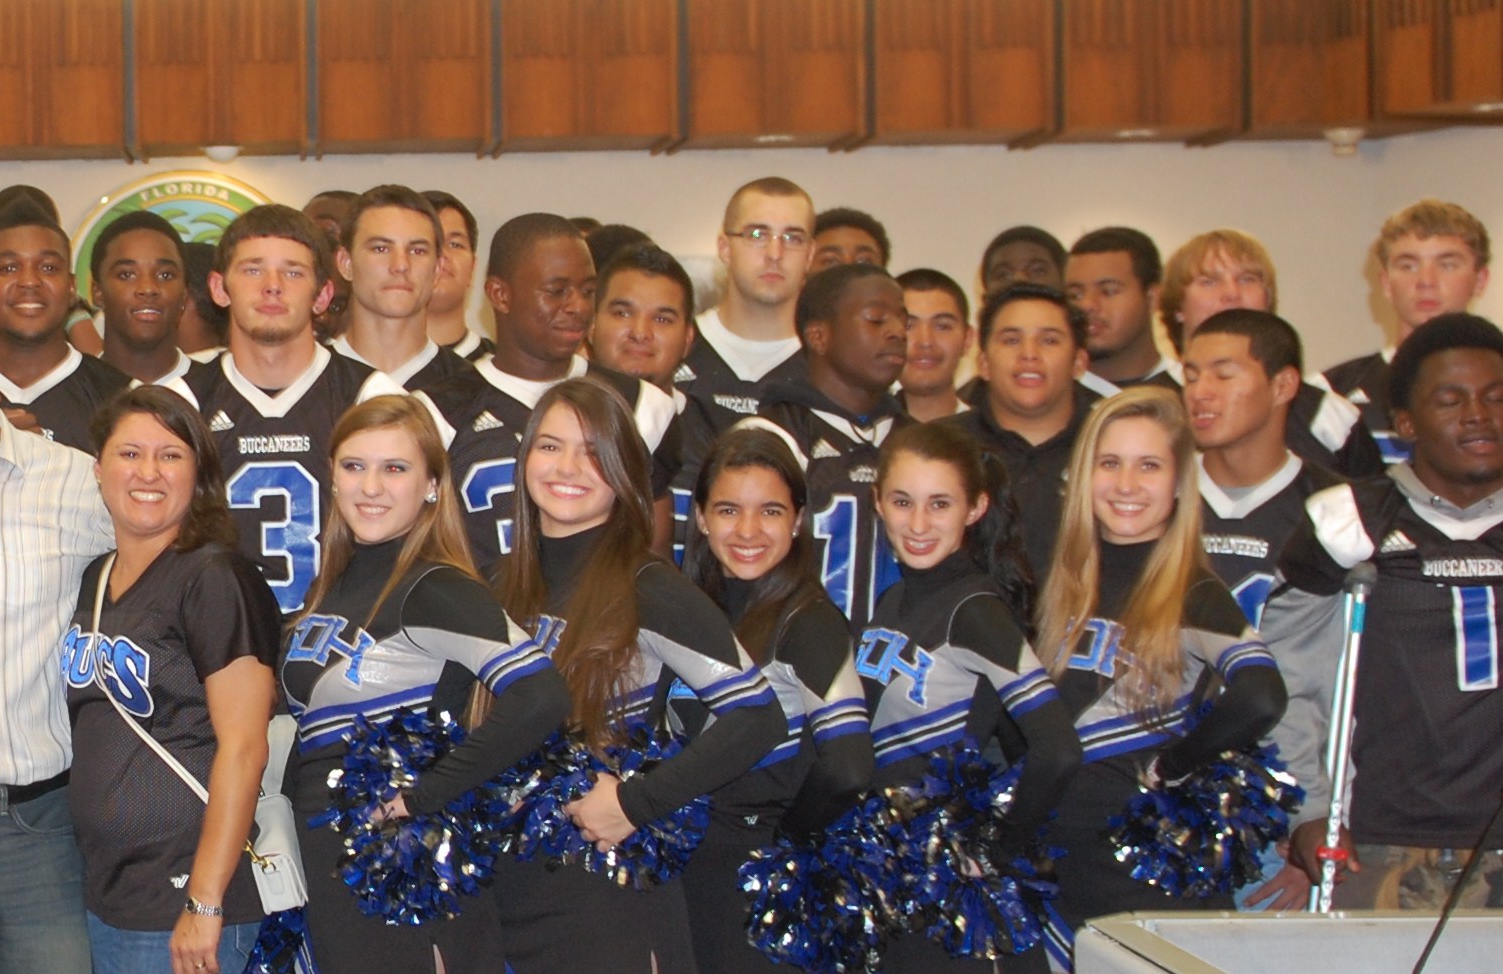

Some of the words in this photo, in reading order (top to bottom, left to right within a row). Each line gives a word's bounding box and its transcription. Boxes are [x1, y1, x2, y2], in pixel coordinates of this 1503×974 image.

[140, 182, 229, 202] FLORIDA
[239, 435, 310, 453] BUCCANEERS
[225, 461, 320, 614] 3
